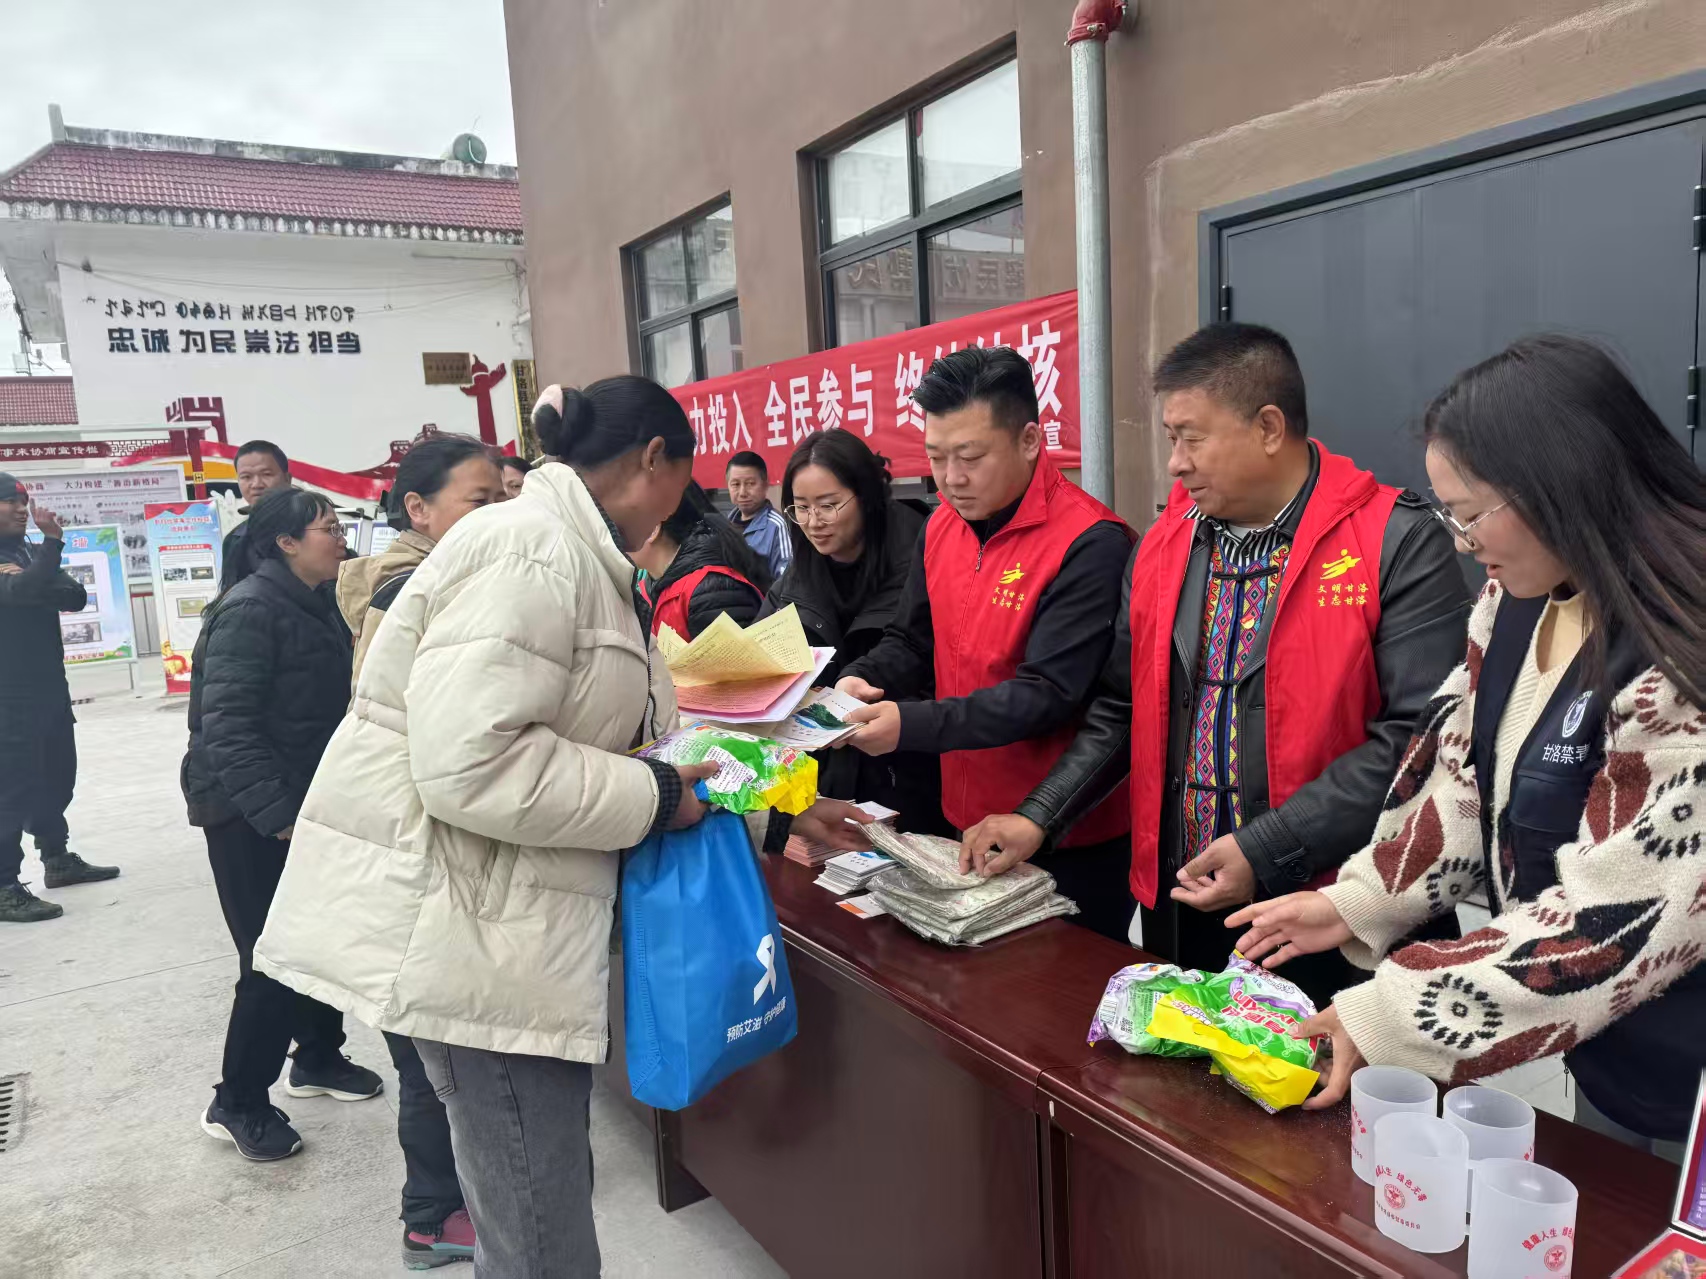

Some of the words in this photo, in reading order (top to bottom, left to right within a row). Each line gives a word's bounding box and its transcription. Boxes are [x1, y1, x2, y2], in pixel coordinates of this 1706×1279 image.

[107, 327, 361, 353] 忠诚为民崇法担当
[763, 363, 874, 447] 全民参与
[895, 319, 1063, 433] 终核
[0, 445, 99, 457] 事来协商宣传栏
